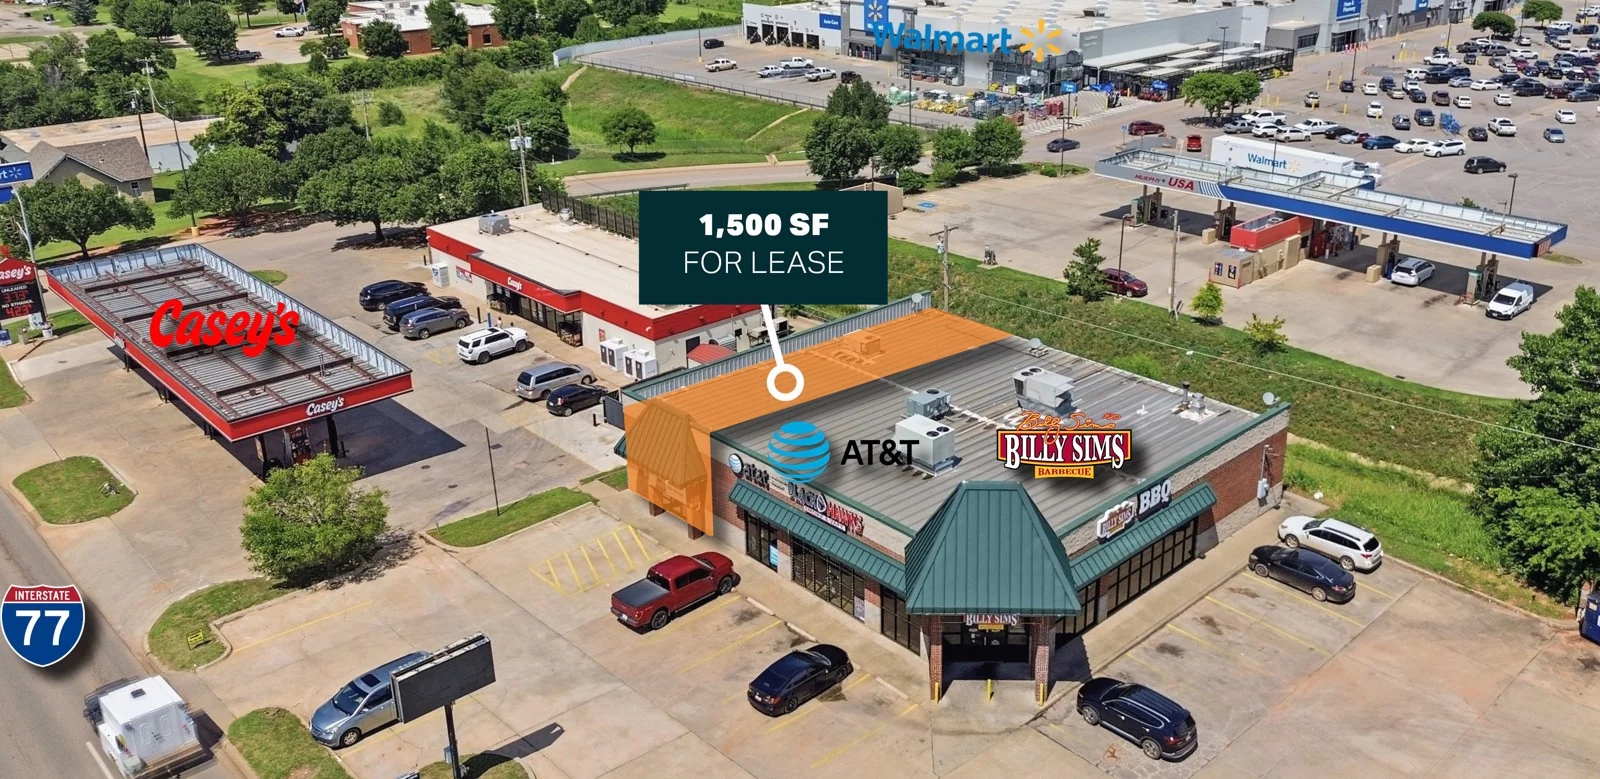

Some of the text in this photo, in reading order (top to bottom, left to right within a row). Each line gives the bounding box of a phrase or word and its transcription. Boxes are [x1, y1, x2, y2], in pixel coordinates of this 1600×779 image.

[1247, 153, 1288, 169] Walmart
[1134, 174, 1194, 191] MURPHY USA
[0, 265, 31, 280] asey's
[306, 396, 345, 417] Casey's
[1139, 479, 1171, 515] BBQ
[966, 613, 1018, 626] BILLY SIMS
